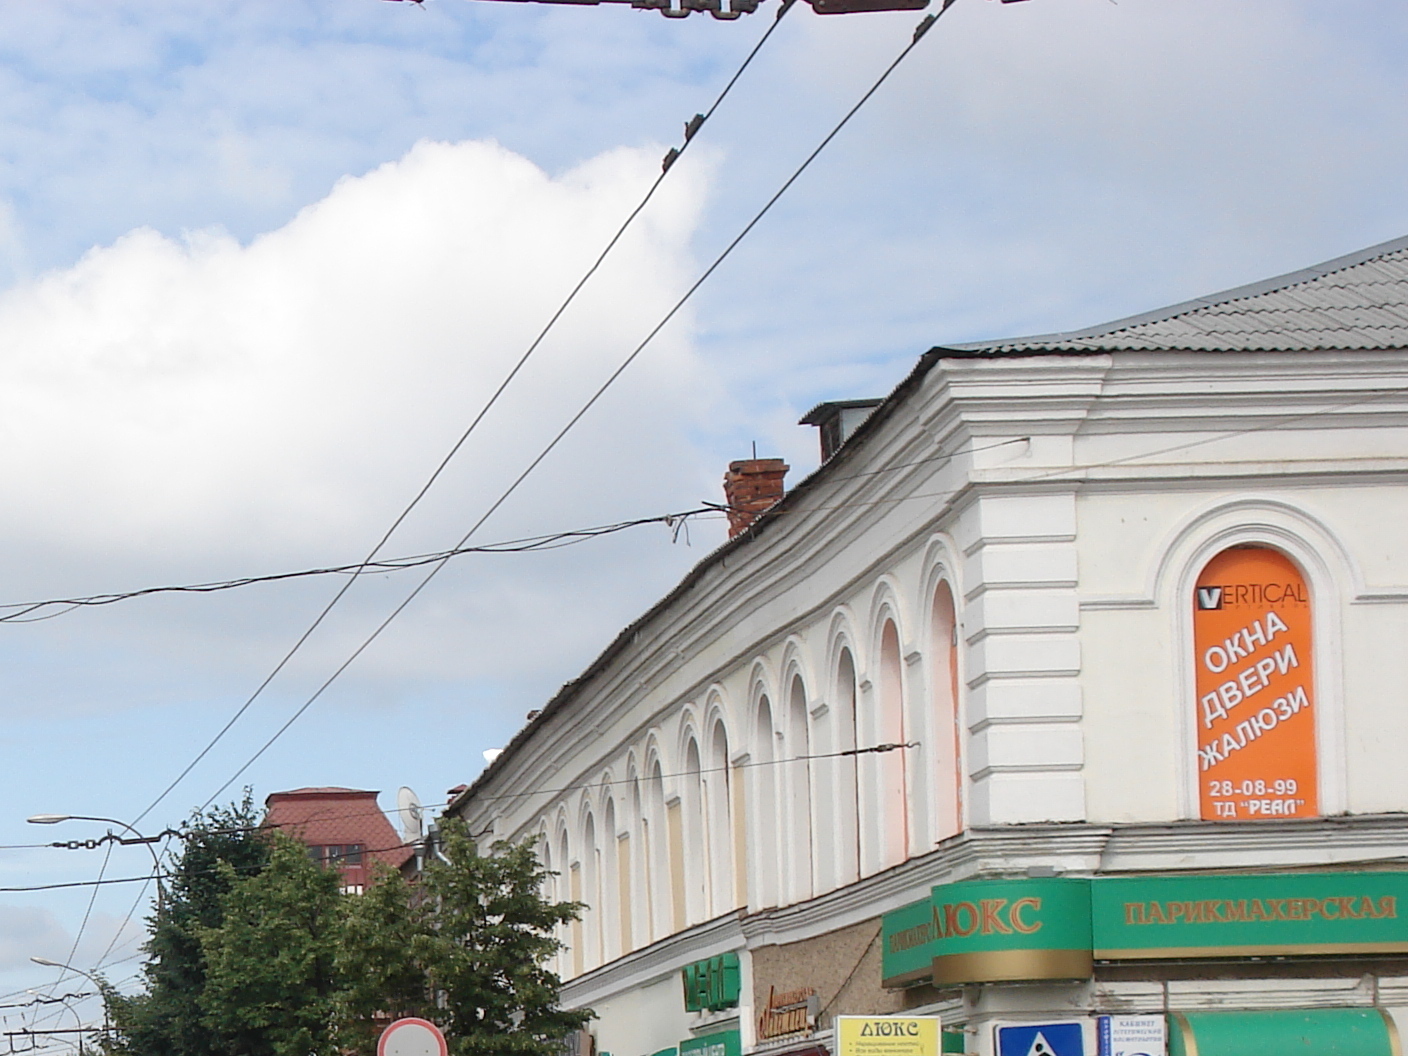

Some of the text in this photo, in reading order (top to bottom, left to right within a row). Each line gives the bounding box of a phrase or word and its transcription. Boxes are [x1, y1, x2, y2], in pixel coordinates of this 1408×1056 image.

[1198, 583, 1307, 610] VERTICAL
[1203, 610, 1290, 674] ОКНА
[1202, 643, 1300, 729] ДВЕРИ
[1198, 685, 1310, 772] ЖАЛЮЗИ
[1209, 779, 1298, 797] 28-08-99
[1213, 801, 1237, 818] ТД
[932, 897, 1043, 940] ЛЮКС
[1123, 896, 1398, 925] ПАРИКМАХЕРСКАЯ
[859, 1021, 919, 1037] ЛЮКС
